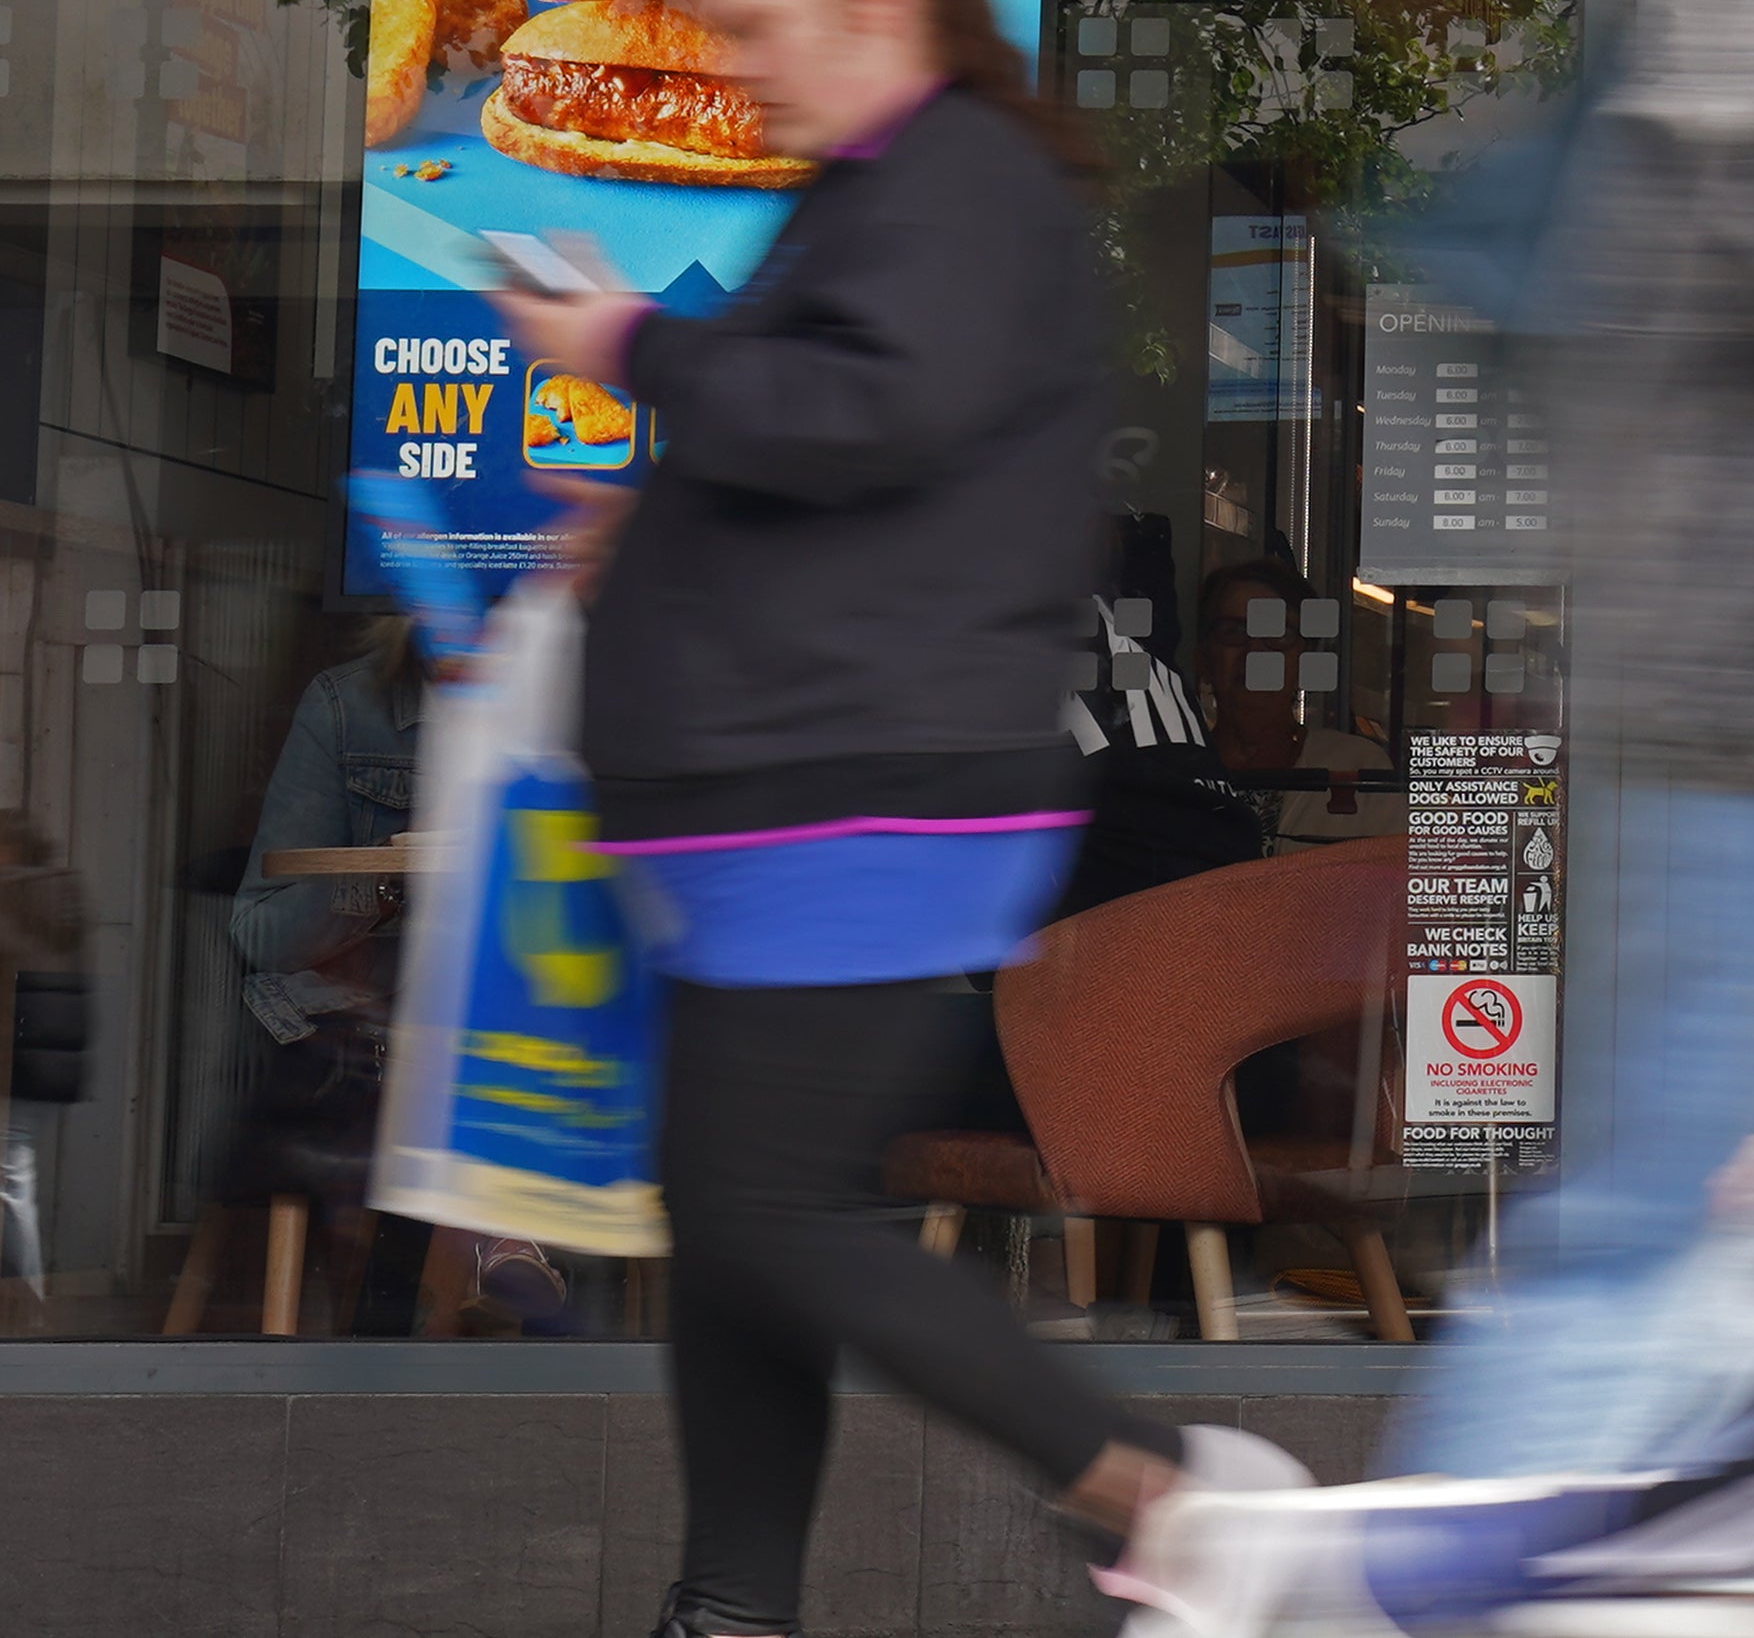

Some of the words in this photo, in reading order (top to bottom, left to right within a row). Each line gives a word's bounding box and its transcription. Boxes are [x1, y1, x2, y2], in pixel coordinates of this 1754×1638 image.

[1379, 314, 1471, 332] OPENIN
[374, 338, 510, 375] CHOOSE
[1376, 365, 1416, 376] Monday
[1376, 390, 1416, 401] Tuesday
[385, 383, 494, 434] ANY
[1375, 416, 1431, 427] Wednesday
[1375, 441, 1421, 452] Thursday
[399, 443, 477, 478] SIDE
[1374, 466, 1406, 478] Friday
[1373, 492, 1419, 503] Saturday
[1372, 517, 1410, 529] Sunday
[1516, 518, 1537, 527] 5.00
[1411, 737, 1429, 746] WE
[1432, 737, 1457, 746] LIKE
[1458, 737, 1475, 746] TO
[1478, 736, 1523, 746] ENSURE
[1410, 747, 1434, 756] THE
[1435, 747, 1477, 756] SAFETY
[1479, 747, 1496, 756] OF
[1498, 747, 1524, 756] OUR
[1410, 757, 1476, 767] CUSTOMERS
[1481, 767, 1503, 775] CCTV
[1409, 781, 1443, 792] ONLY
[1446, 781, 1518, 791] ASSISTANCE
[1409, 793, 1448, 805] DOGS
[1451, 793, 1519, 804] ALLOWED
[1409, 812, 1458, 825] GOOD
[1462, 812, 1508, 825] FOOD
[1409, 826, 1431, 835] FOR
[1432, 826, 1465, 835] GOOD
[1467, 826, 1508, 835] CAUSES
[1408, 878, 1450, 894] OUR
[1454, 878, 1508, 893] TEAM
[1408, 895, 1457, 905] DESERVE
[1460, 895, 1508, 905] RESPECT
[1518, 914, 1542, 922] HELP
[1425, 928, 1450, 941] WE
[1453, 928, 1507, 941] CHECK
[1407, 944, 1452, 957] BANK
[1456, 943, 1508, 956] NOTES
[1426, 1063, 1453, 1076] NO
[1458, 1063, 1538, 1076] SMOKING
[1452, 1099, 1482, 1108] against
[1429, 1109, 1455, 1117] smoke
[1493, 1110, 1532, 1118] premises.
[1403, 1127, 1446, 1139] FOOD
[1450, 1127, 1480, 1139] FOR
[1483, 1127, 1555, 1139] THOUGHT
